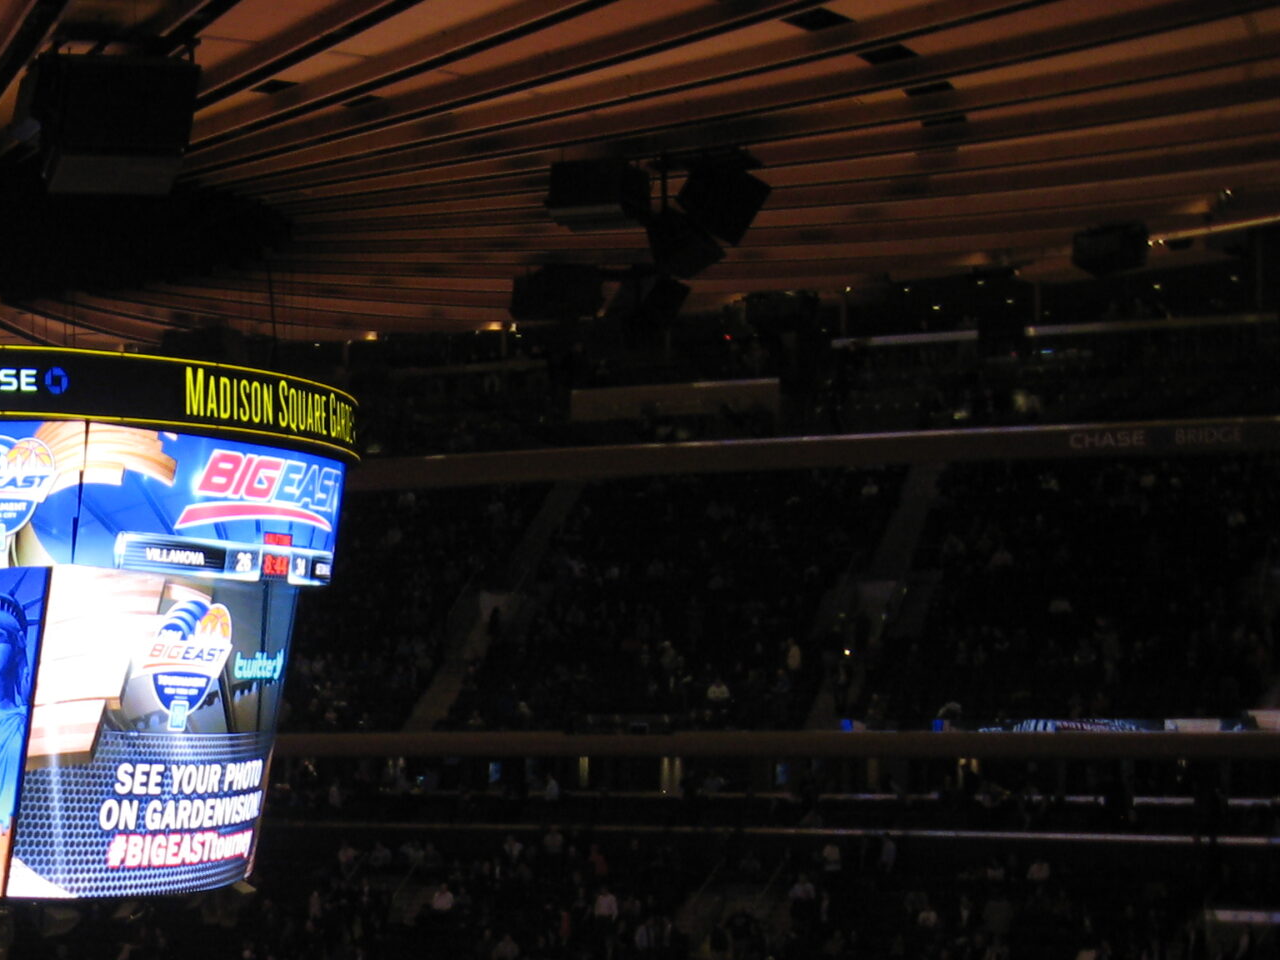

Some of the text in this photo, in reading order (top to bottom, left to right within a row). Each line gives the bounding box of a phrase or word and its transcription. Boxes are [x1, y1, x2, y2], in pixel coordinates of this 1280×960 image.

[185, 366, 274, 425] MADISON
[279, 379, 327, 436] SQUARE
[1069, 427, 1244, 448] CHASE BRIDGE
[146, 546, 206, 566] VILLANOVA
[236, 552, 253, 572] 26
[263, 554, 290, 576] 8:44
[114, 758, 263, 796] SEE YOUR PHOTO
[99, 798, 139, 831] ON
